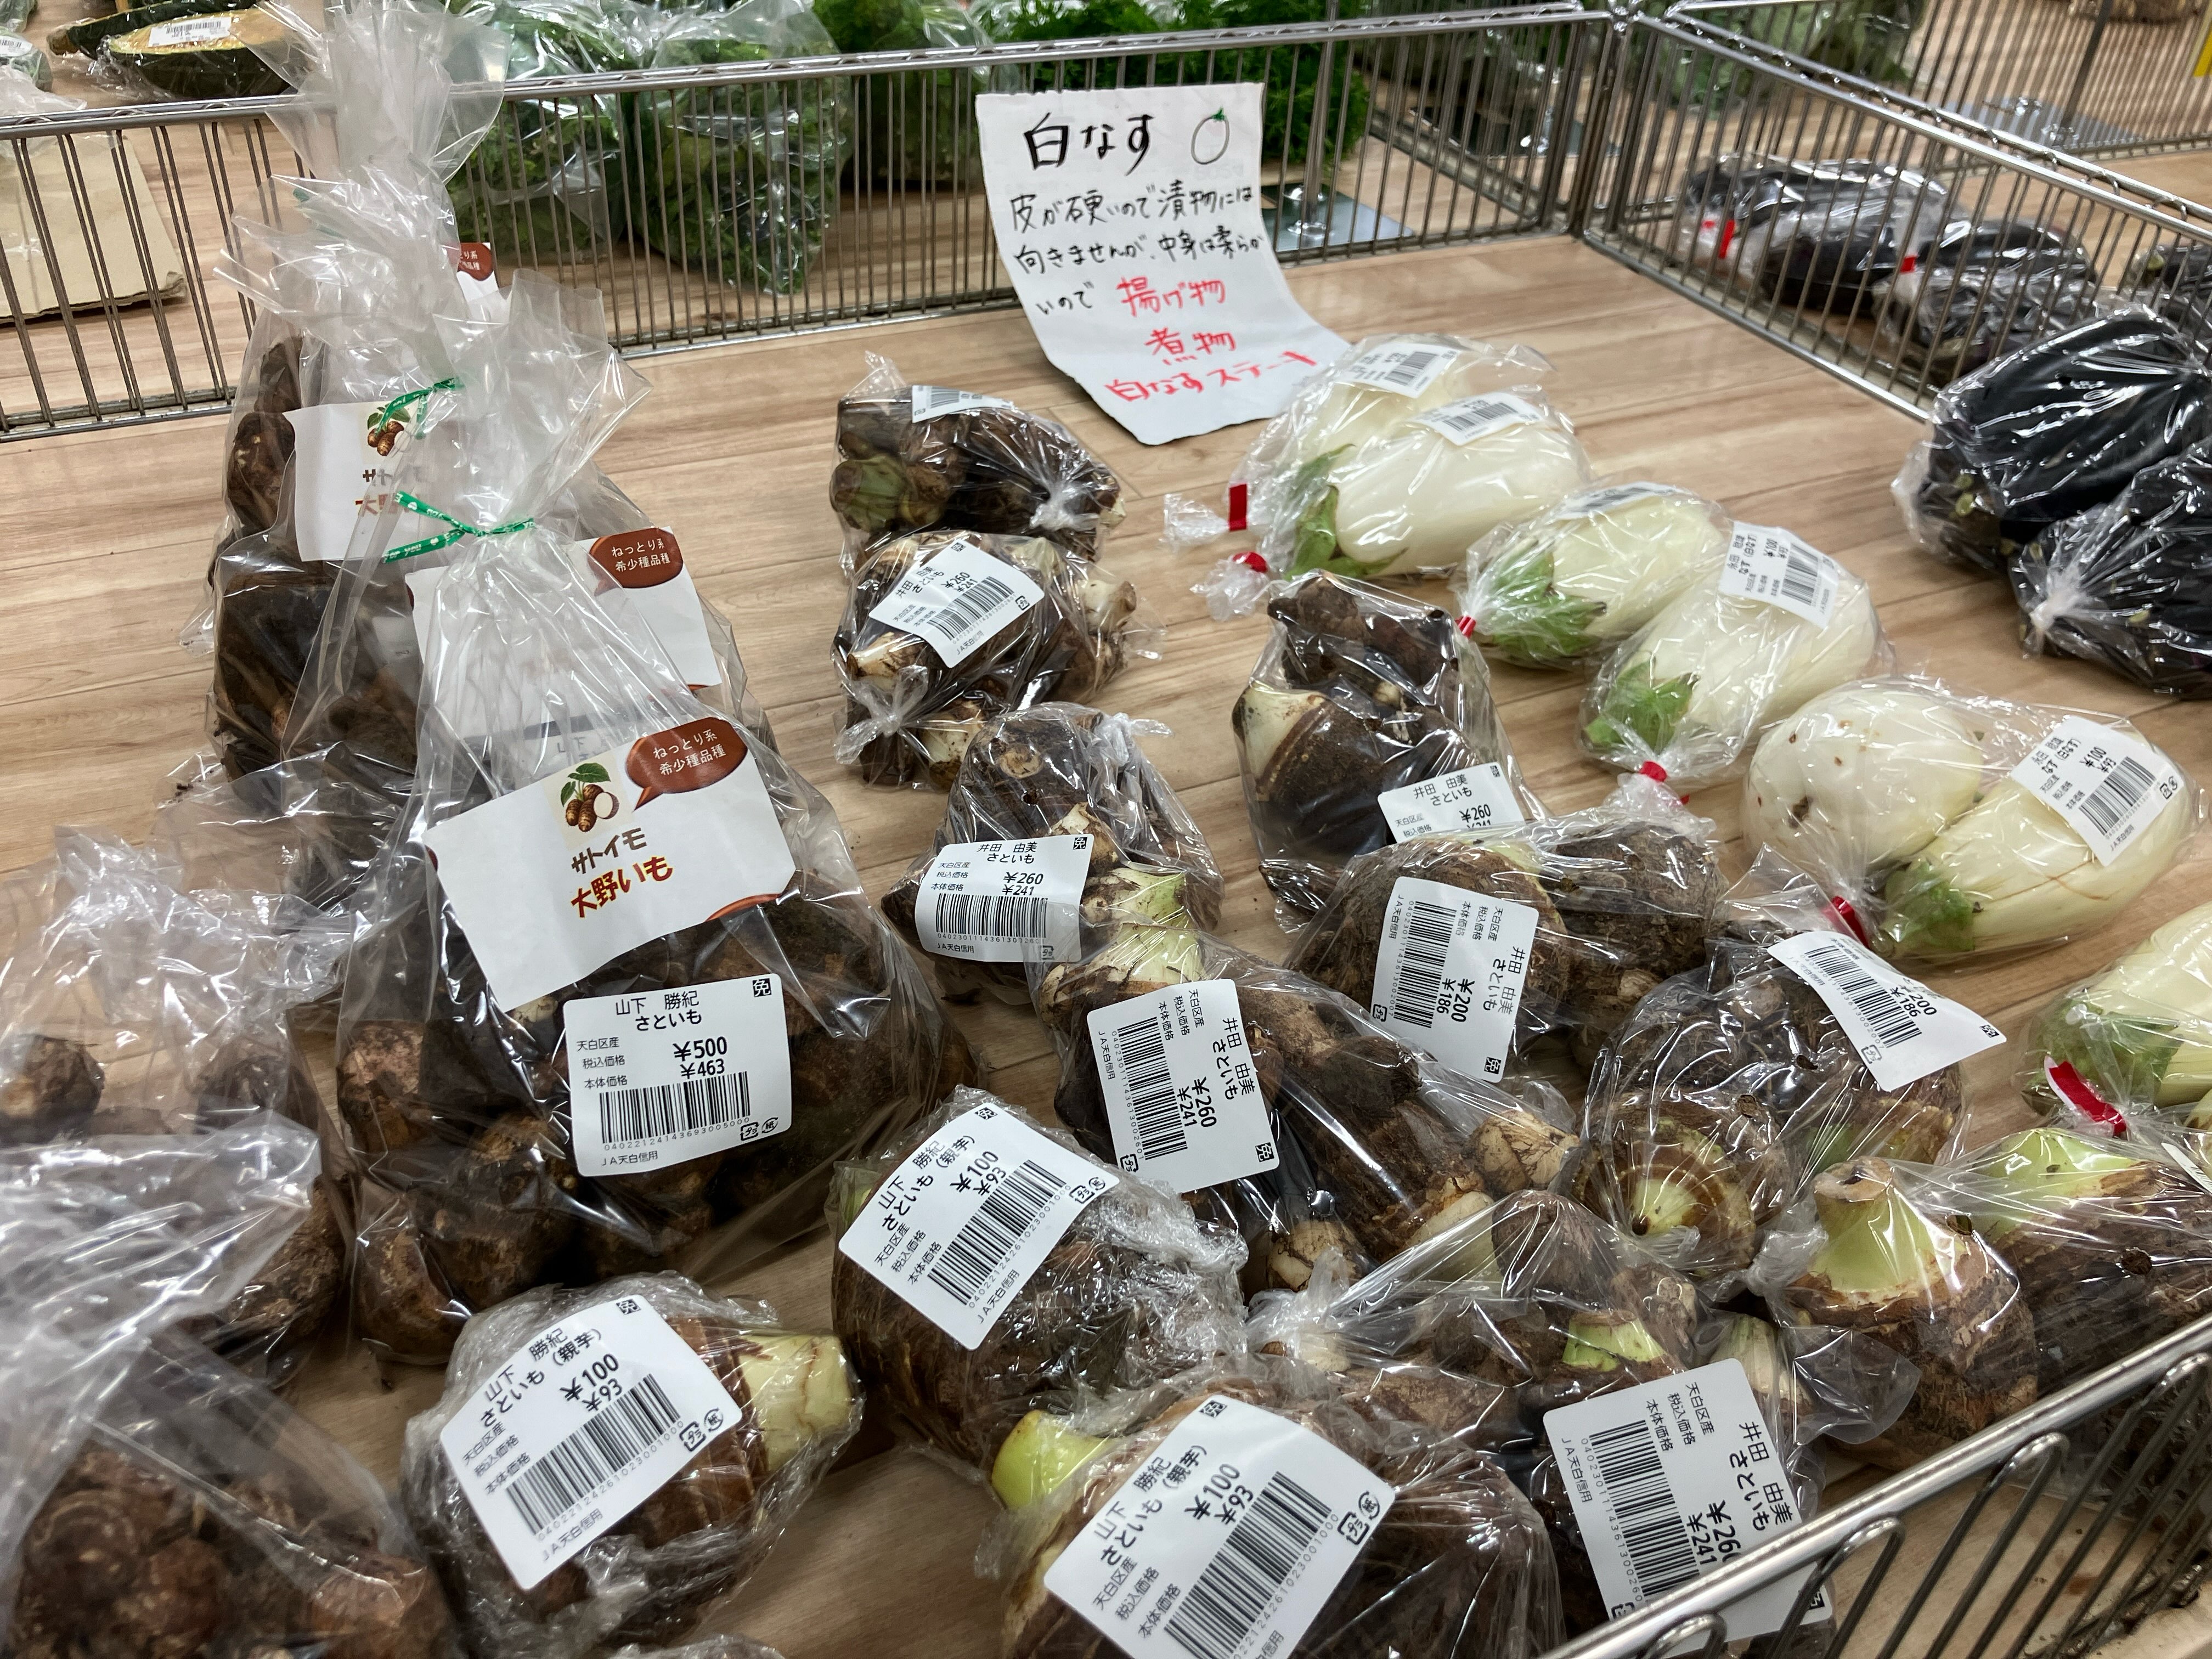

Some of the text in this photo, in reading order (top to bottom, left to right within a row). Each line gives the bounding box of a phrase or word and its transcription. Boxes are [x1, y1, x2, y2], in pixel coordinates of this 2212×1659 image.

[1024, 112, 1155, 177] 白なす
[1010, 179, 1255, 233] 皮が硬いので漬物には
[1036, 276, 1226, 317] いので 揚げ物
[1144, 327, 1237, 365] 煮物
[611, 538, 665, 557] ねっとり系
[615, 552, 670, 572] 希少種品種
[912, 571, 944, 593] さといも
[941, 572, 970, 589] ¥260
[955, 578, 978, 593] ¥241
[653, 729, 718, 760] ねっとり系
[659, 746, 726, 776] 希少種品種
[2079, 746, 2107, 768] ¥100
[1413, 774, 1468, 799] 井田 由美
[1430, 787, 1472, 806] さといも
[1459, 803, 1491, 823] ¥260
[571, 827, 648, 875] サトイモ
[977, 842, 1038, 853] 井田 由美
[986, 853, 1035, 864] さといも
[571, 856, 674, 919] 大野いも
[931, 883, 1035, 896] 本体価格 ¥241
[1003, 871, 1044, 885] ¥260
[1487, 905, 1504, 942] 天白区産
[1436, 900, 1471, 1015] 本体価格 ¥186
[1451, 905, 1488, 1023] 税込価格 ¥200
[615, 990, 699, 1015] 山下 勝紀
[1483, 958, 1506, 1011] さといも
[1499, 946, 1526, 1015] 井田 由美
[1889, 986, 1921, 1018] ¥186
[635, 1009, 702, 1031] さといも
[1188, 988, 1205, 1029] 天白区産
[577, 1036, 619, 1052] 天白区産
[582, 1036, 727, 1069] 税込価格 ¥500
[1098, 1031, 1115, 1080] JA天白信用
[1158, 1001, 1198, 1127] 本体価格 ¥241
[1173, 995, 1217, 1127] 税込価格 ¥260
[1222, 1017, 1256, 1096] 井田 由美
[584, 1058, 725, 1090] 本体価格 ¥463
[1212, 1039, 1239, 1101] さといも
[601, 1150, 658, 1166] JA天白信用
[878, 1140, 945, 1209] 山下 勝紀
[890, 1150, 1000, 1273] 税込価格 ¥100
[907, 1165, 1007, 1285] 本体価格 ¥93
[874, 1224, 911, 1266] 天白区産
[484, 1327, 568, 1403] 山下 勝紀
[559, 1353, 620, 1403] ¥100
[582, 1378, 623, 1413] ¥93
[1685, 1381, 1715, 1436] 天白区産
[1666, 1392, 1697, 1446] 税込価格
[462, 1421, 506, 1466] 天白区産
[1645, 1398, 1718, 1566] 本体価格 ¥241
[1729, 1450, 1770, 1532] さといも
[1738, 1421, 1793, 1526] 井田 由美
[1093, 1456, 1172, 1542] 山下 勝紀
[1580, 1437, 1644, 1602] 0402301114361300260
[1115, 1463, 1241, 1621] 税込価格 ¥100
[1137, 1483, 1255, 1640] 本体価格 ¥93
[1092, 1559, 1138, 1611] 天白区産
